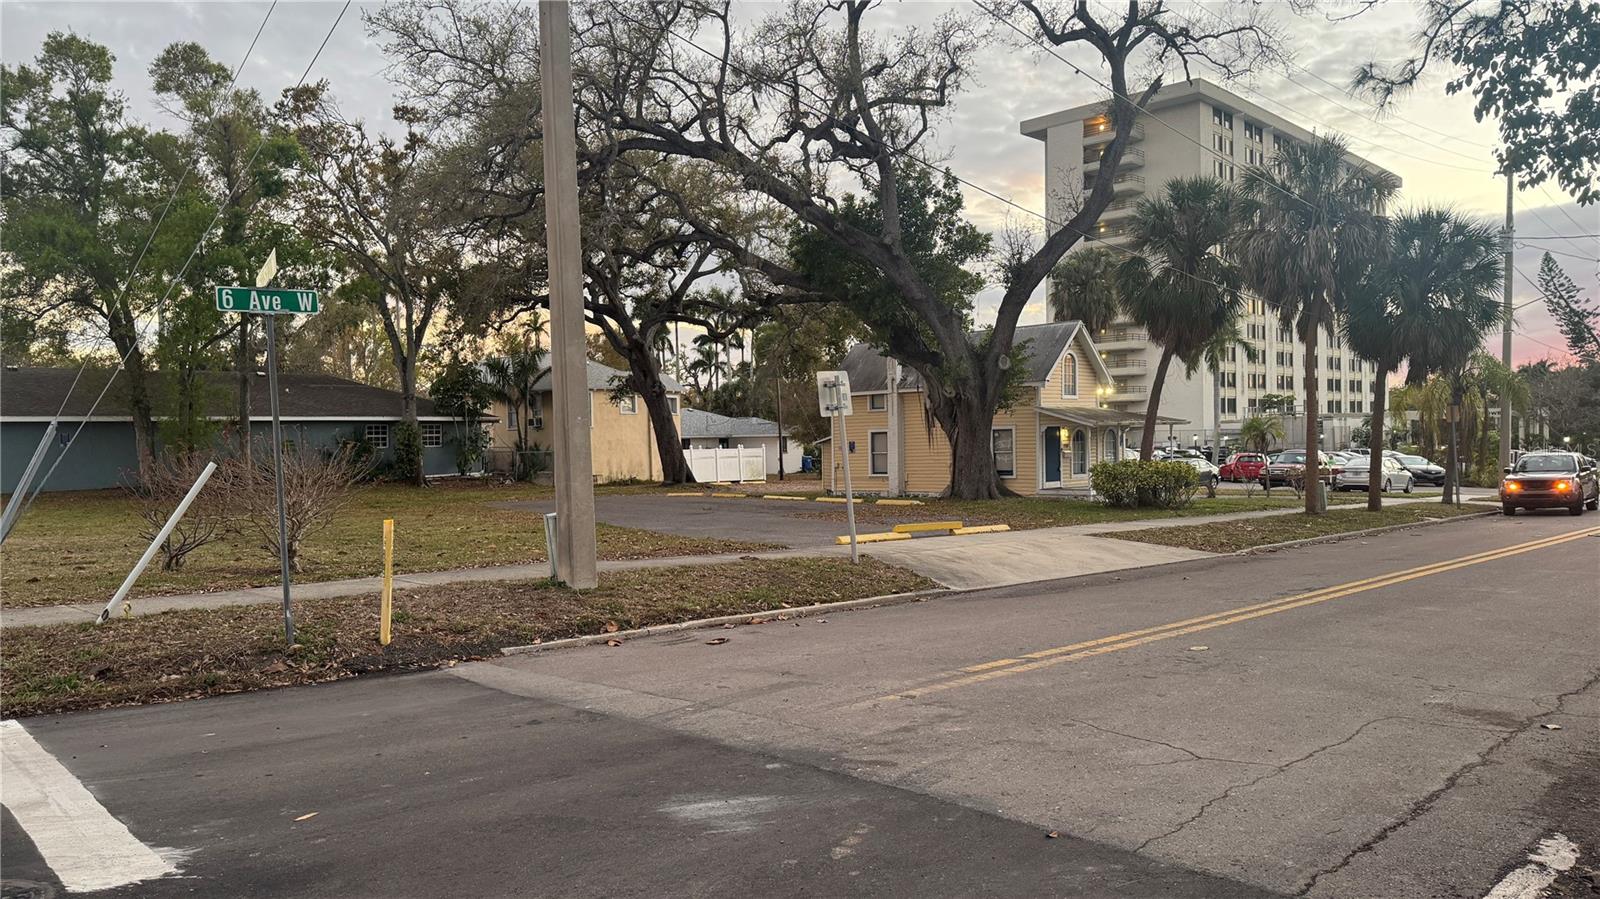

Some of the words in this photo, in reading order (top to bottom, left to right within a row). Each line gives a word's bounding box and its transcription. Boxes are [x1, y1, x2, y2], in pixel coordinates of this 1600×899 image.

[222, 289, 234, 309] 6
[249, 290, 281, 310] Ave
[297, 292, 313, 311] W
